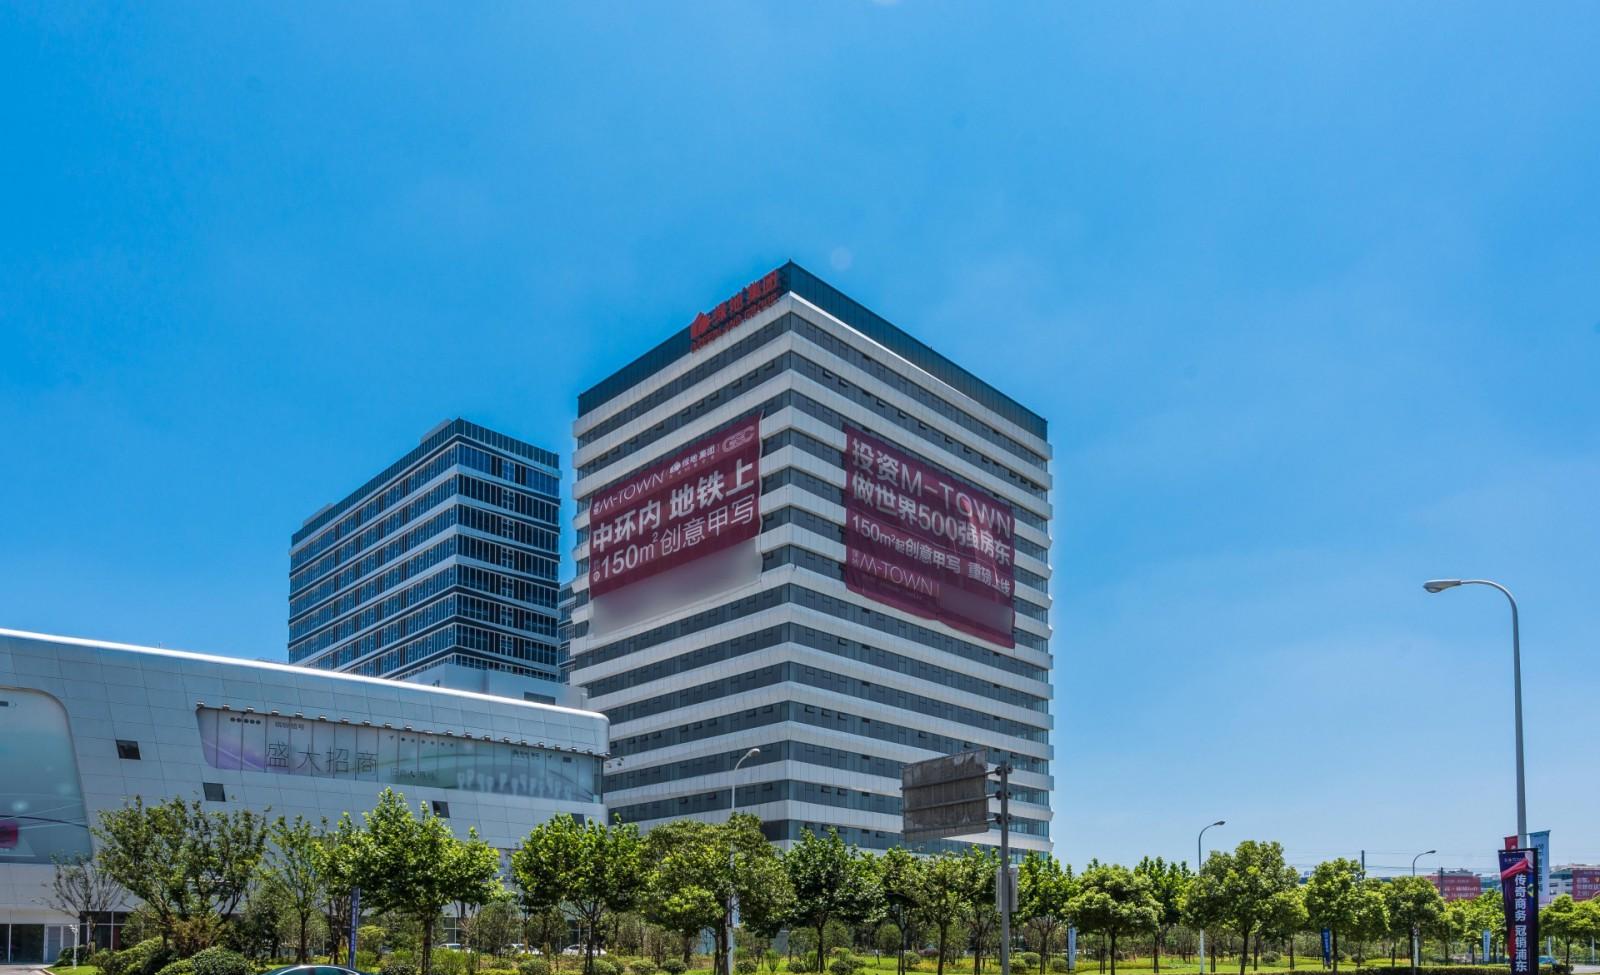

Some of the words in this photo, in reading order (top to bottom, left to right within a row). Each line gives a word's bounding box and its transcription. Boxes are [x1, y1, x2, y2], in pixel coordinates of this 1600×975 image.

[593, 500, 661, 552] 中环内
[669, 458, 754, 521] 地铁上
[599, 470, 665, 513] M-TOWN
[852, 437, 1010, 539] 投资M-TOWN
[852, 471, 1010, 566] 做世界500强房东
[860, 553, 933, 596] M-TOWN
[267, 740, 377, 776] 盛大招商
[1514, 873, 1527, 922] 传奇商务
